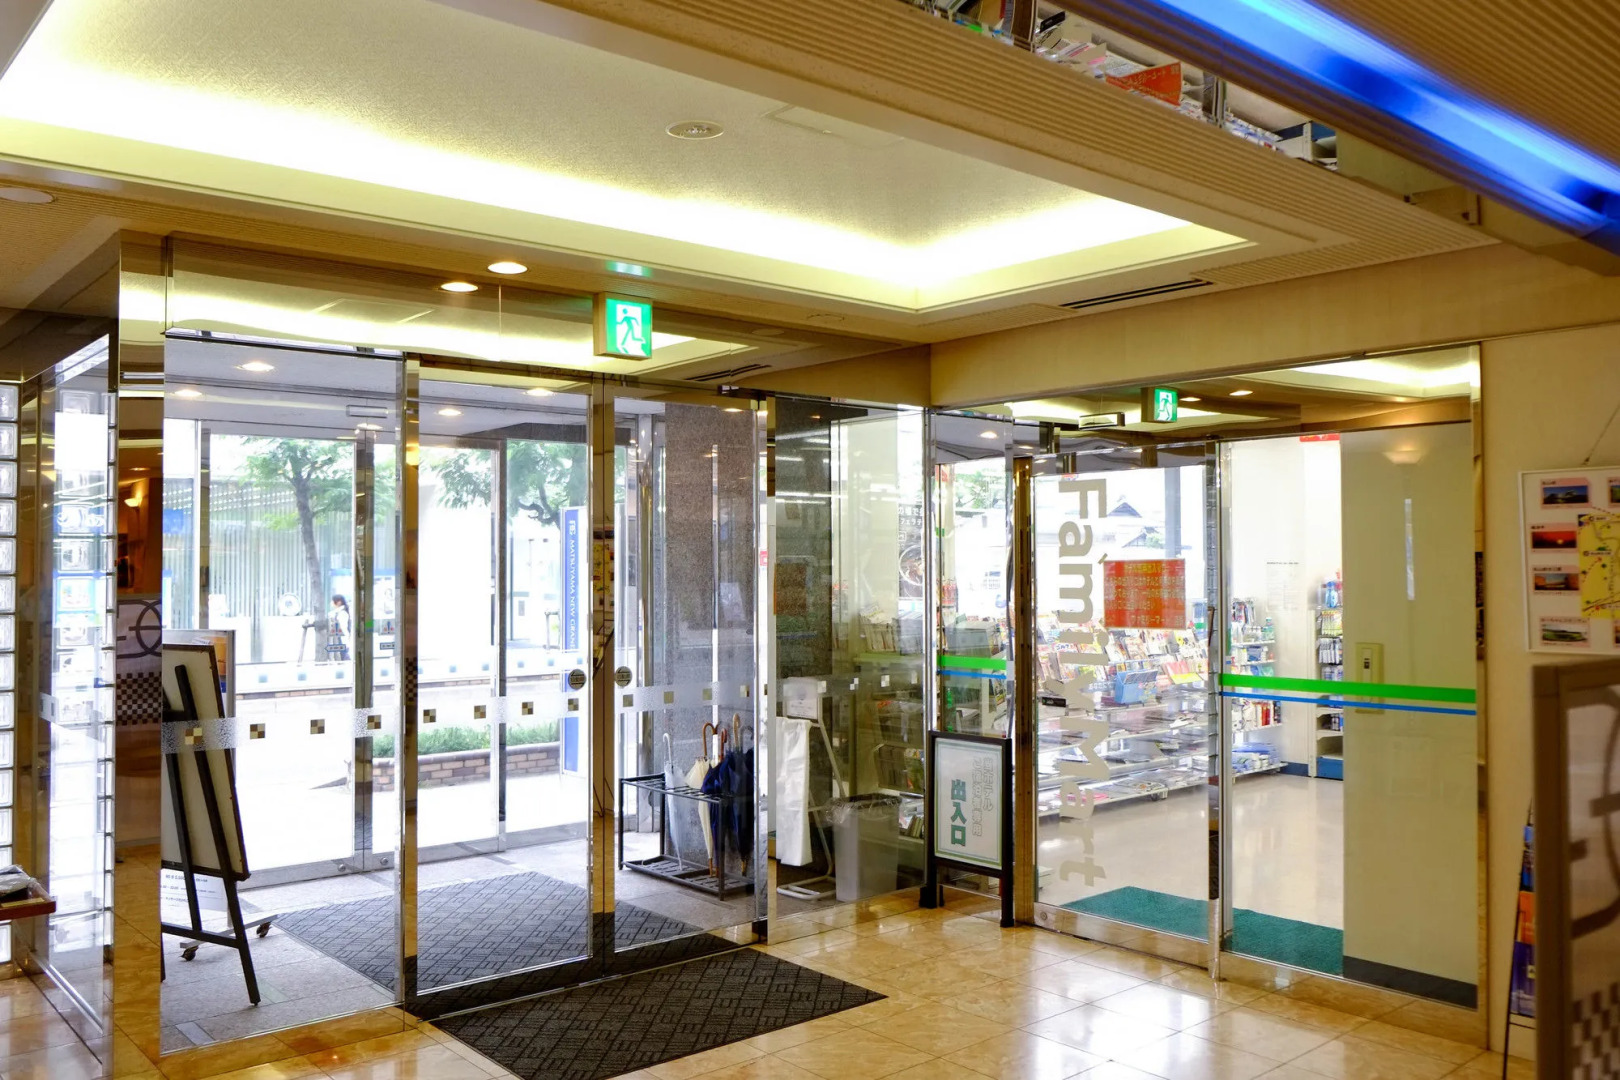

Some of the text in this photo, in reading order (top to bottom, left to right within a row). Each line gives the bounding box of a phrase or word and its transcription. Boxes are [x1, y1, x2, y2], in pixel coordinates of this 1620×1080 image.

[1042, 478, 1110, 887] FamilyMart
[951, 779, 967, 847] 出入口
[983, 757, 994, 812] 当ホテル
